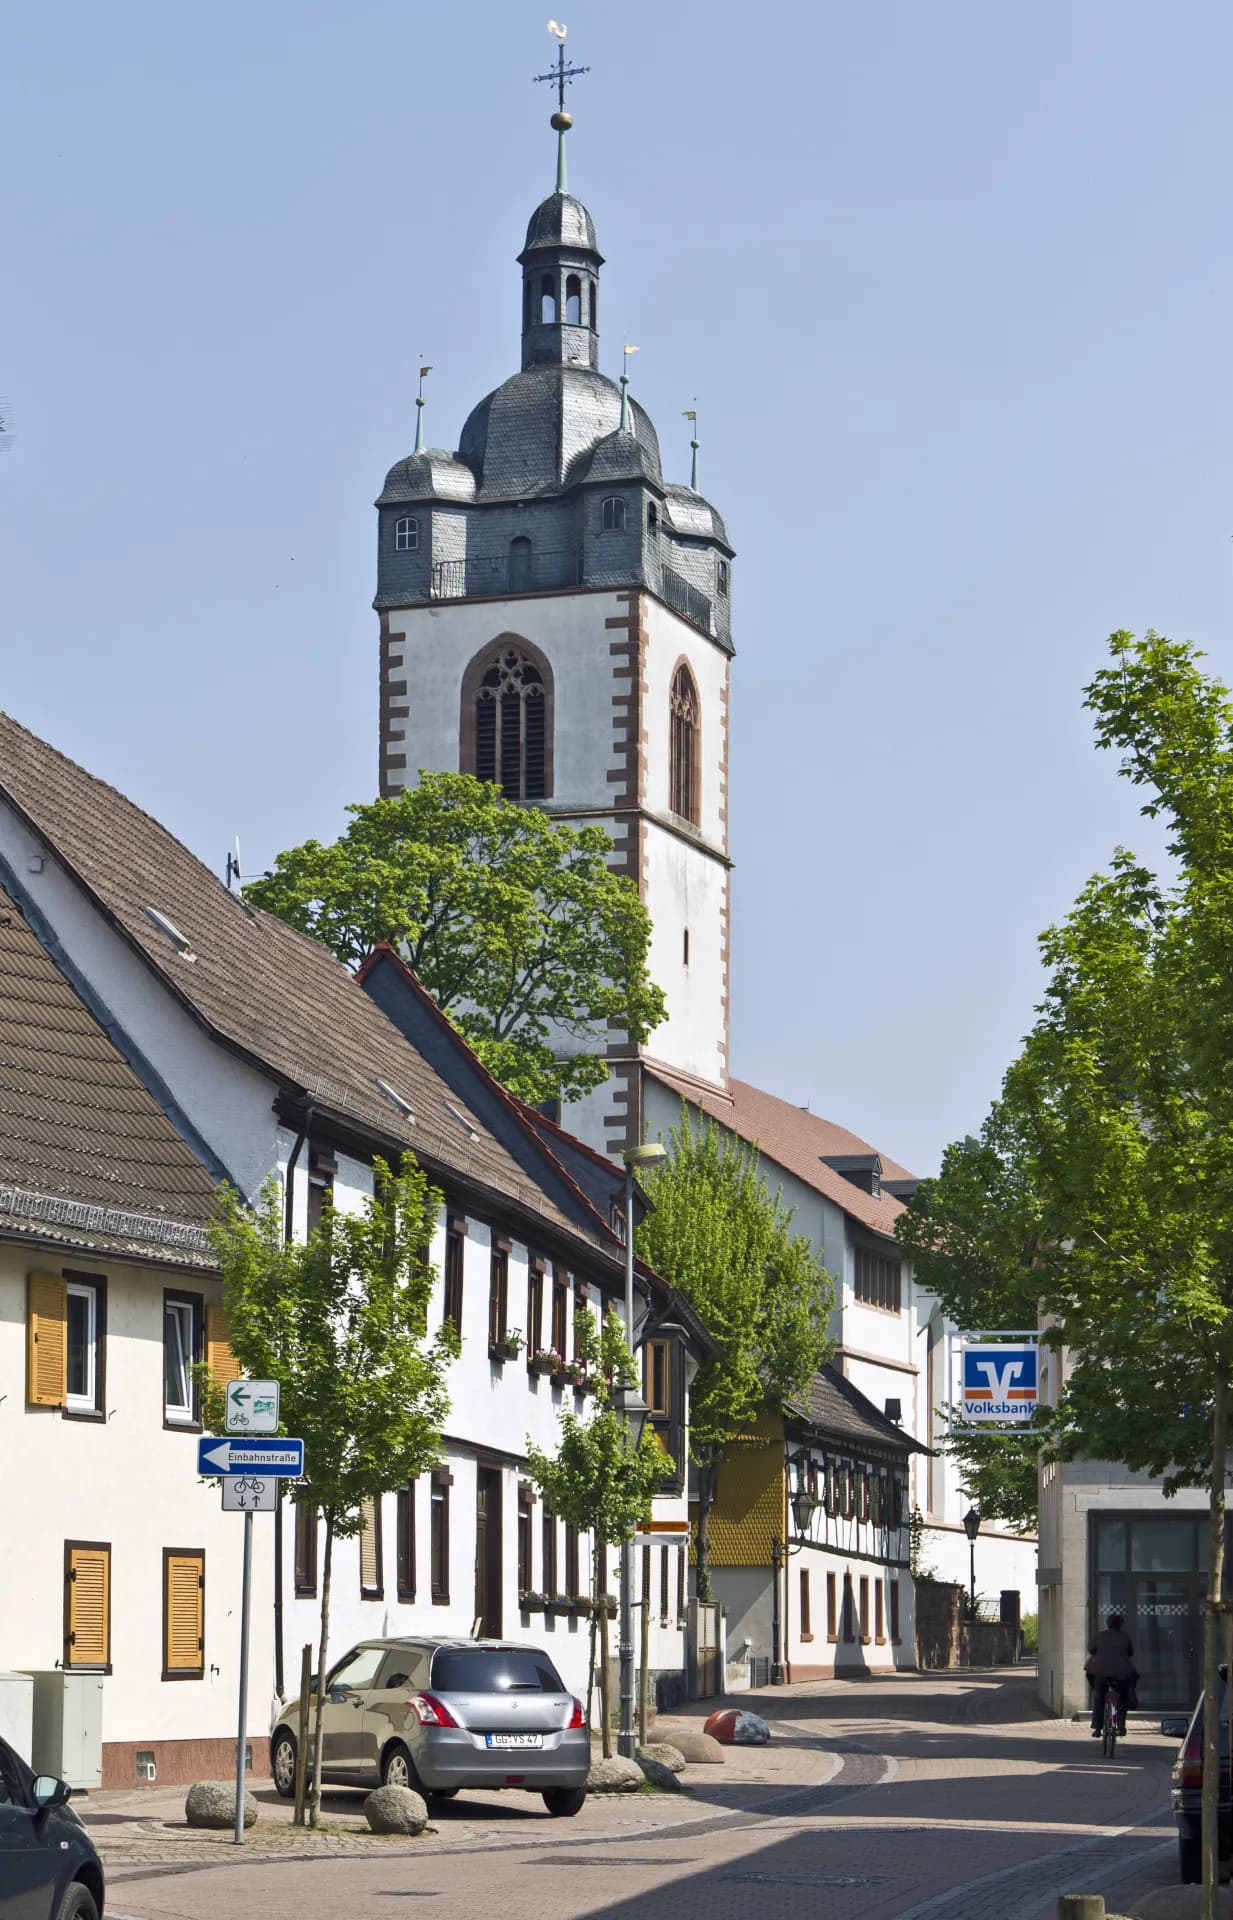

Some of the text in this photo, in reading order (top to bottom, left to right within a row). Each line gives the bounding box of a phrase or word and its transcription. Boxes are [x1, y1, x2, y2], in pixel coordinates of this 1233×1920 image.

[965, 1402, 1036, 1414] Volksbank
[228, 1452, 297, 1462] Einbahnstraße
[495, 1734, 508, 1744] GG
